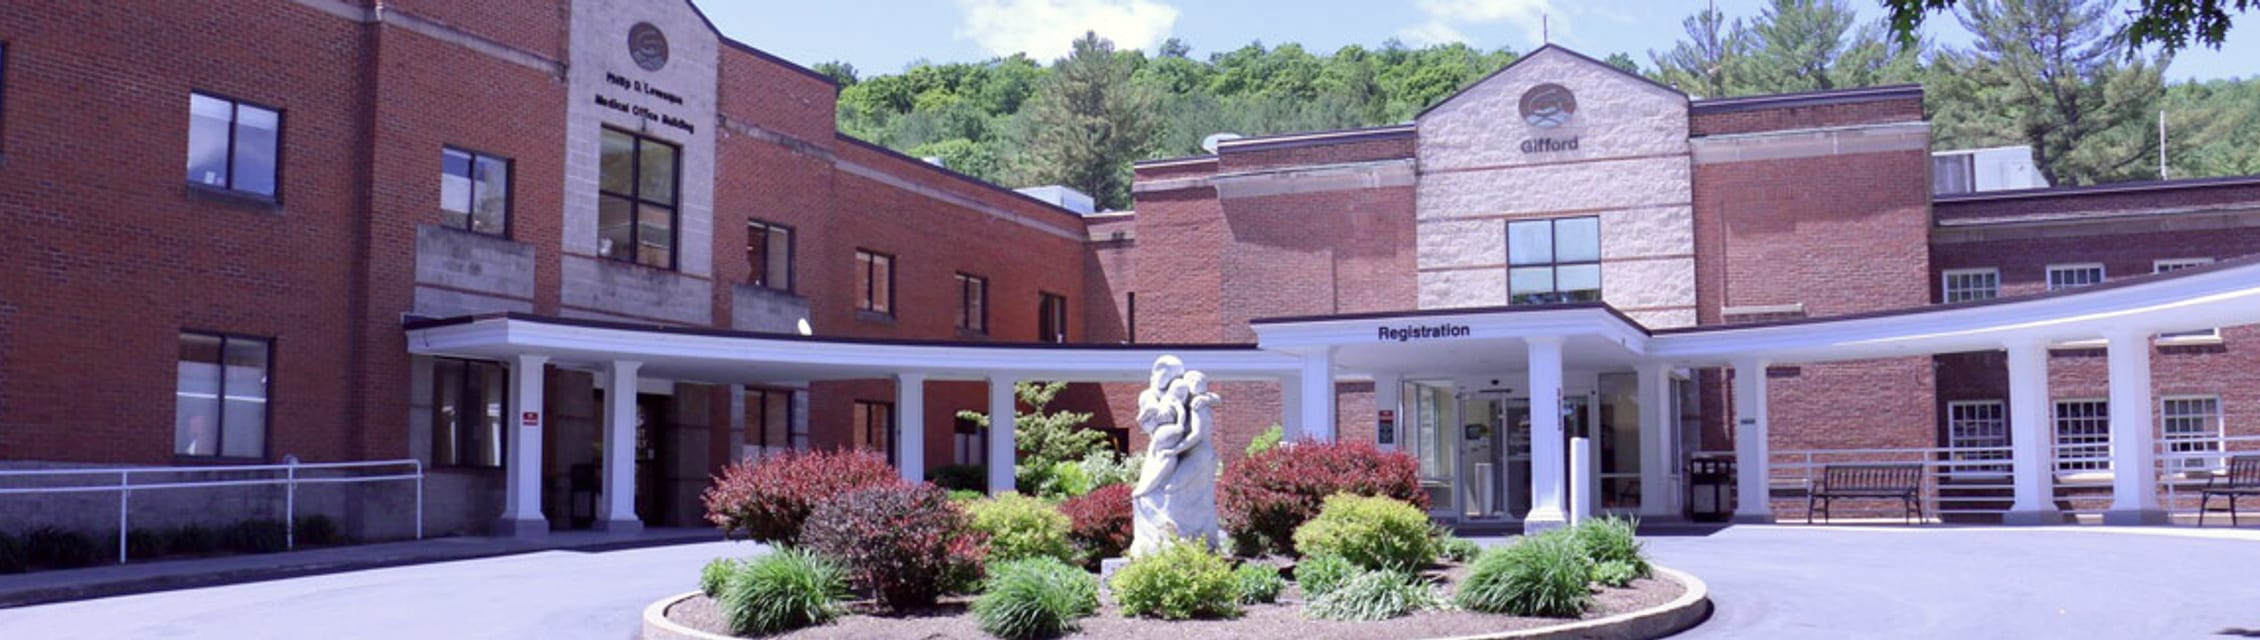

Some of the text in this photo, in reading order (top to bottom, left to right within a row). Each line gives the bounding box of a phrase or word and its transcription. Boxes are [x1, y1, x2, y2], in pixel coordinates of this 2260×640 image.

[594, 94, 694, 135] Medical Office Building
[1520, 135, 1579, 154] Gifford
[1378, 323, 1470, 342] Registration
